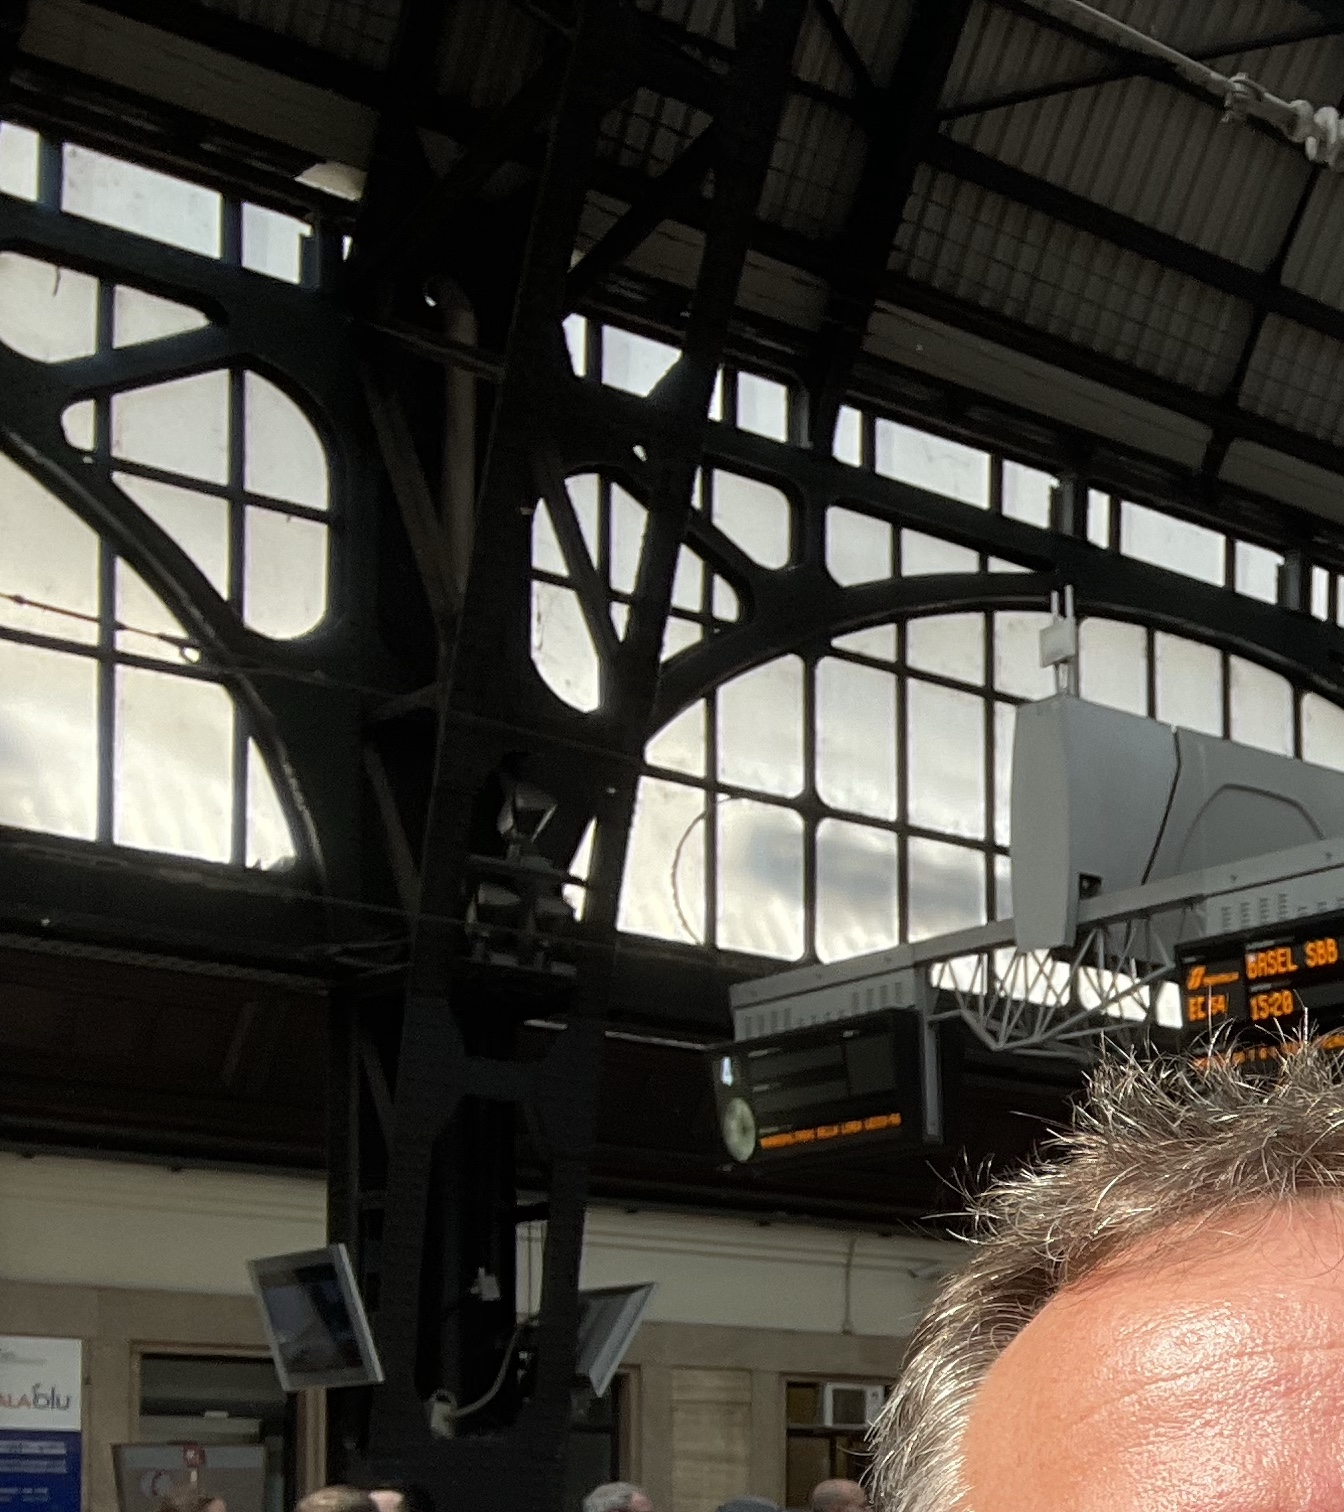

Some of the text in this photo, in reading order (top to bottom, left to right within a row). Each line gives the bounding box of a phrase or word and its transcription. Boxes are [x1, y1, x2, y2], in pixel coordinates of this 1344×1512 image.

[1245, 937, 1339, 980] BASEL SBB
[1250, 989, 1294, 1021] 15:20
